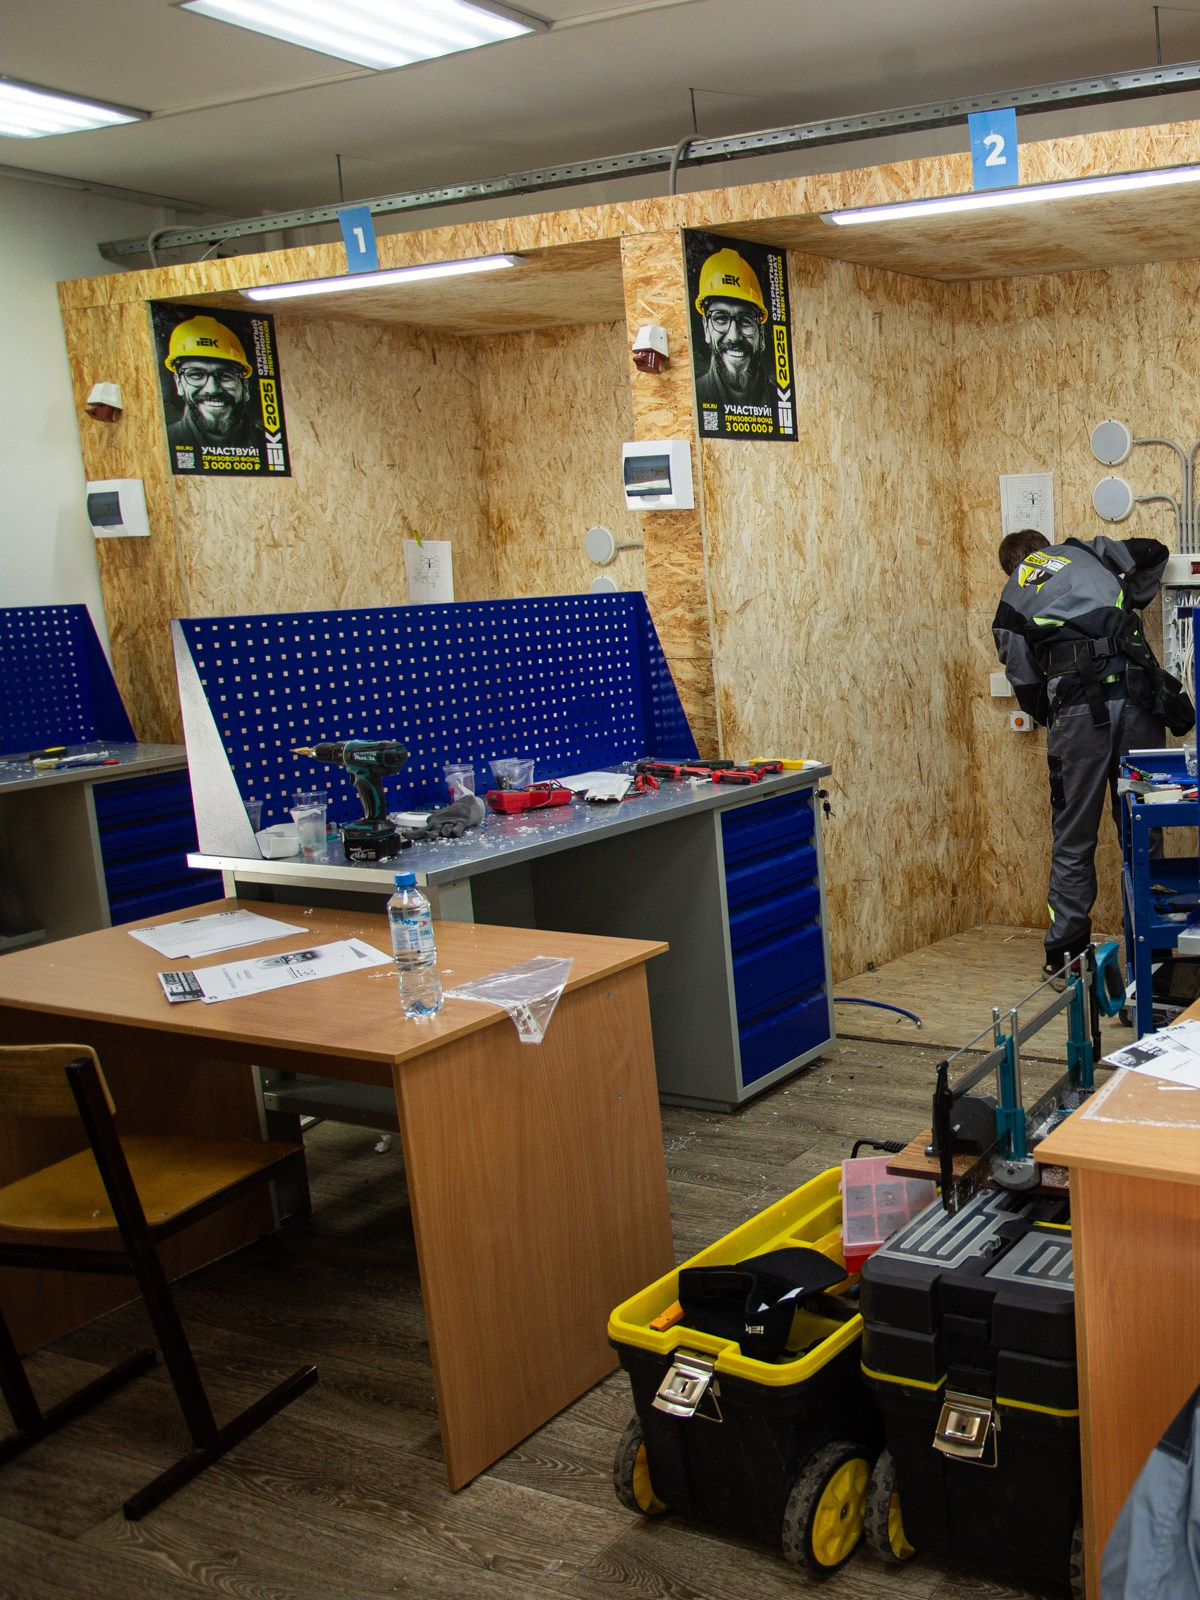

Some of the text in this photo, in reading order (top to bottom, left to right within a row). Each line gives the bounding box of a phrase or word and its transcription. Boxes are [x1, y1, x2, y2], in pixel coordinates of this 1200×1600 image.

[983, 134, 1006, 166] 2
[353, 227, 366, 253] 1
[722, 274, 741, 287] IEK
[767, 254, 777, 320] ОТКРЫТЫЙ
[777, 256, 786, 322] ЭЛЕКТРИКОВ
[196, 337, 219, 348] IEK
[776, 329, 788, 381] 2025
[263, 382, 277, 426] 2025
[724, 404, 772, 416] УЧАСТВУЙ!
[777, 388, 793, 434] IEK
[725, 414, 773, 424] ПРИЗОВОЙ ФОНД
[726, 423, 731, 431] 3
[732, 423, 750, 432] 000
[752, 424, 767, 433] 000
[202, 446, 259, 456] УЧАСТВУЙ!
[265, 431, 285, 471] IEK
[211, 462, 231, 470] 000
